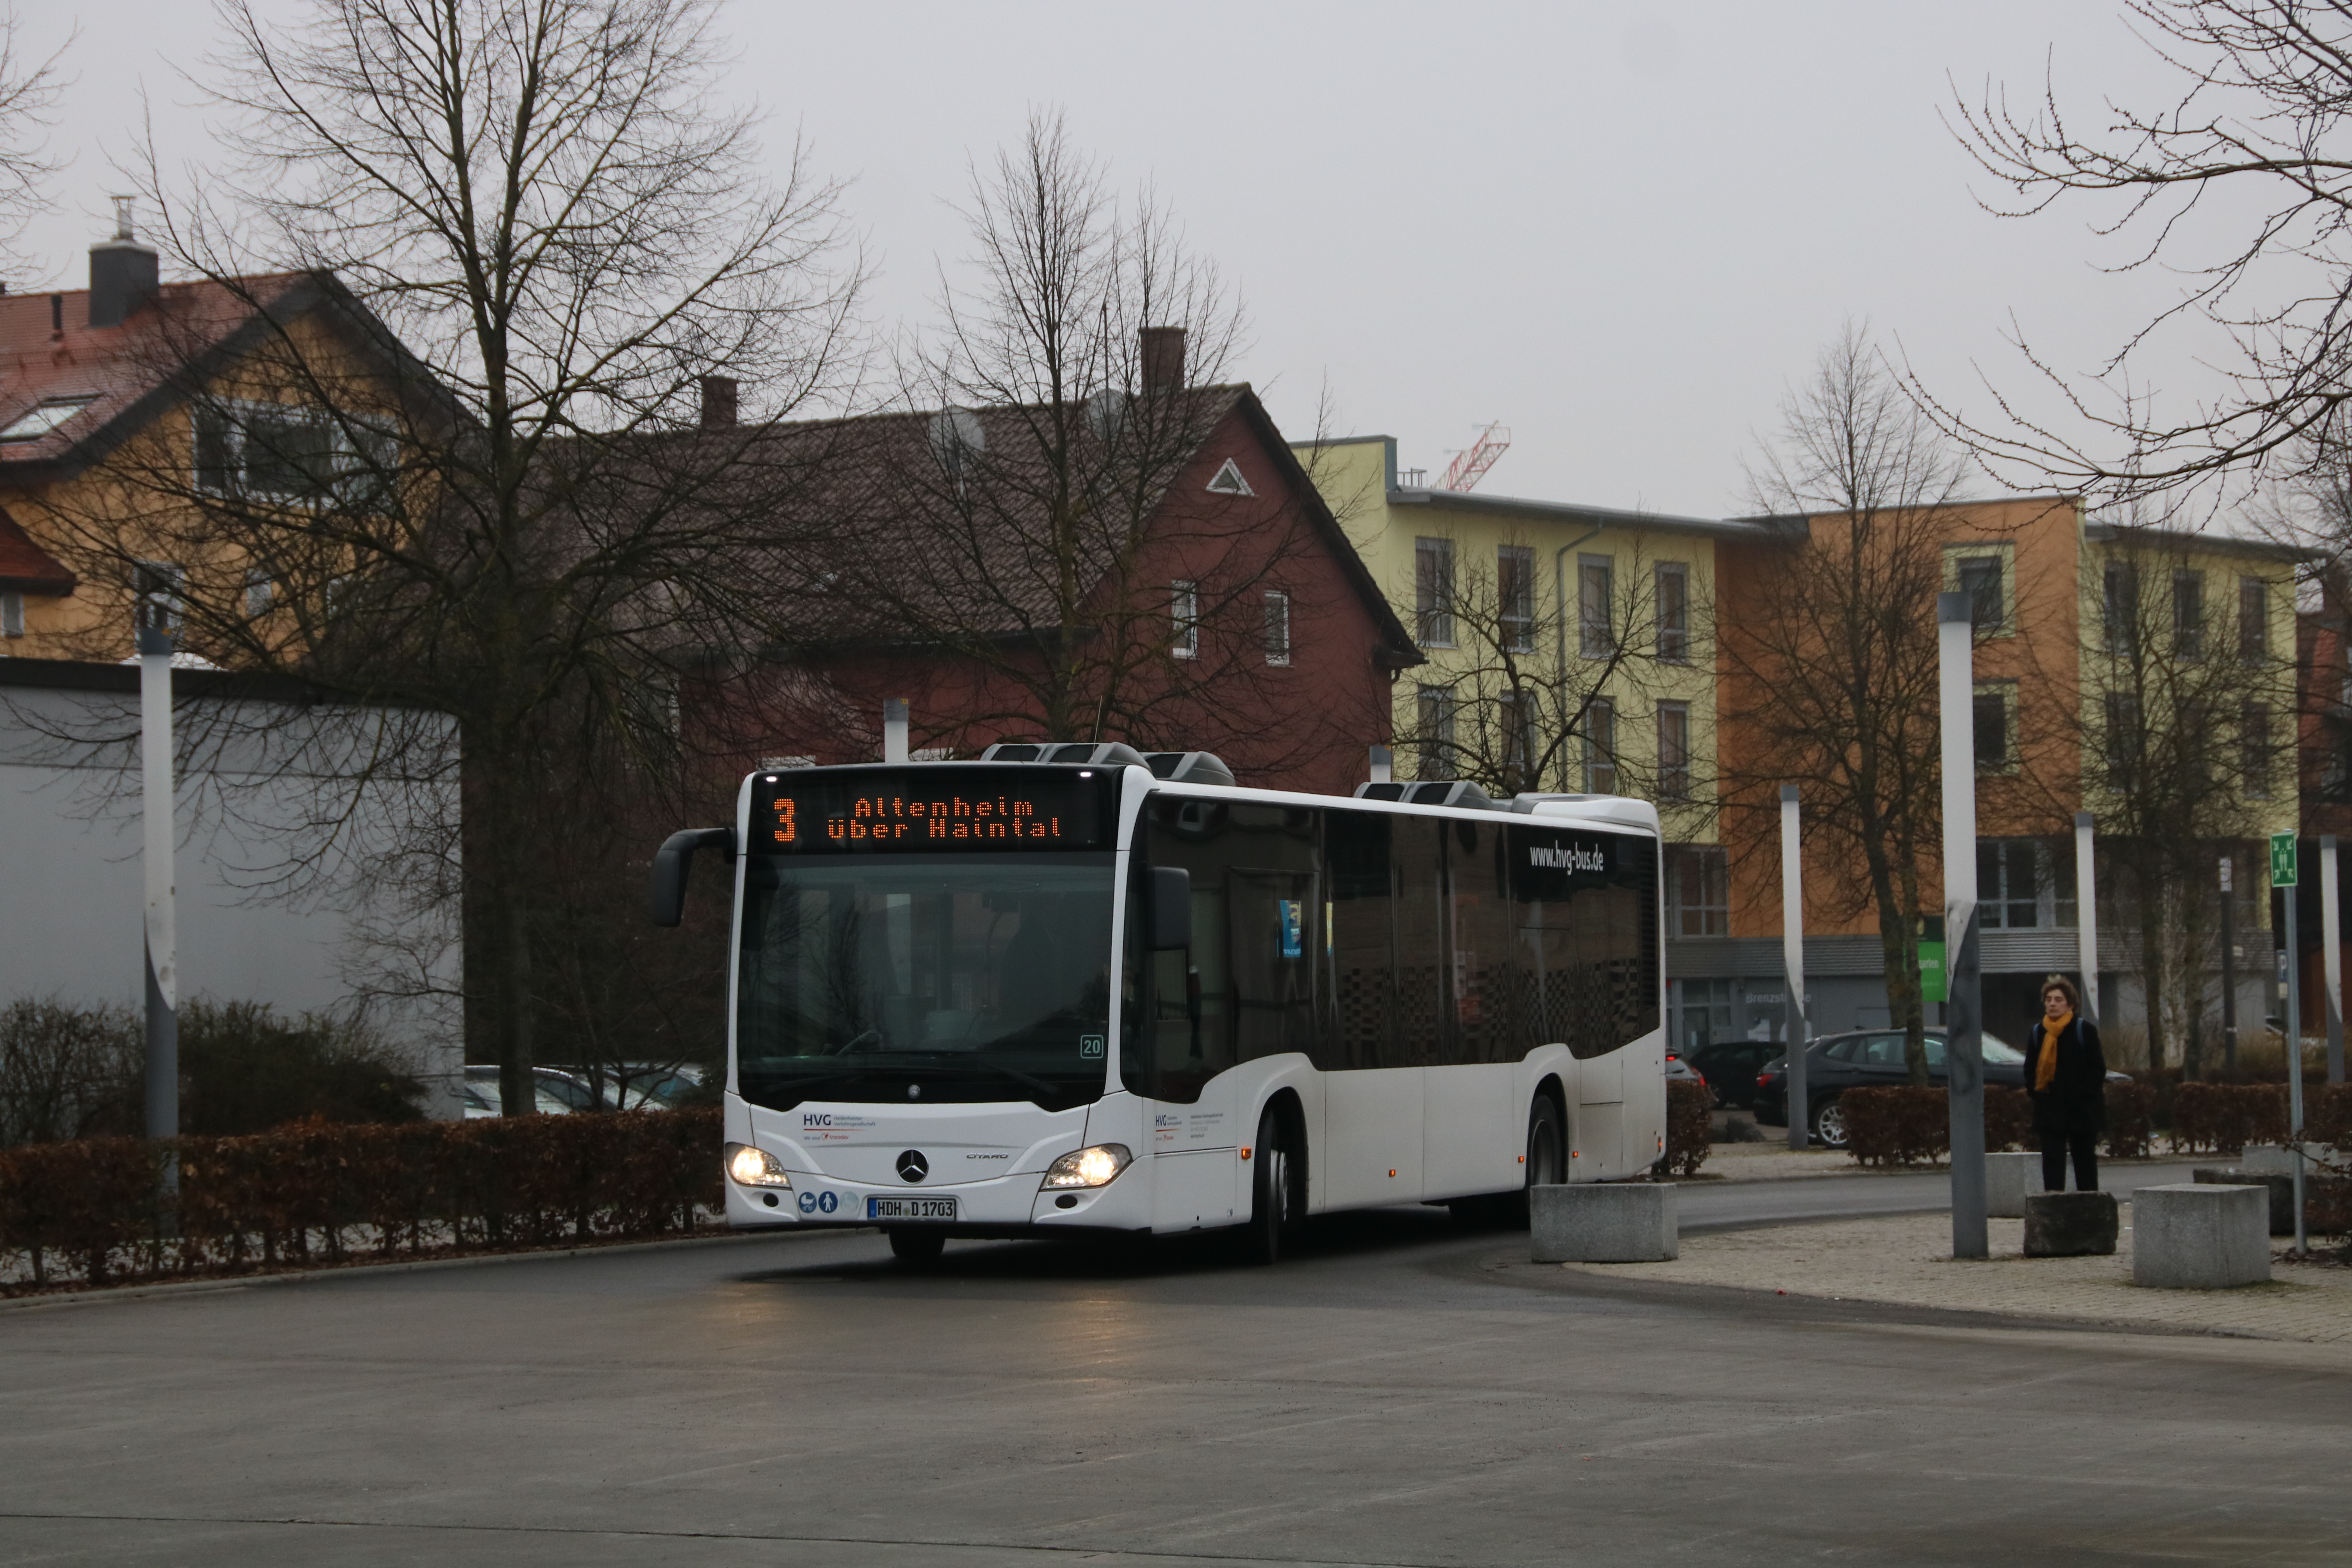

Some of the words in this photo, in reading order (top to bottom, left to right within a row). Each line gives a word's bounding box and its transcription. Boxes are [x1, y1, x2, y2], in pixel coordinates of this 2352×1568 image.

[855, 797, 1033, 817] Altenheim
[774, 799, 795, 841] 3
[829, 819, 908, 838] über
[929, 817, 1060, 837] Haintal
[1530, 839, 1604, 876] www.hvg-bus.de
[1084, 1040, 1100, 1053] 20
[804, 1114, 831, 1126] HVG
[878, 1201, 901, 1216] HDH
[911, 1201, 918, 1216] D
[922, 1201, 953, 1216] 1703
